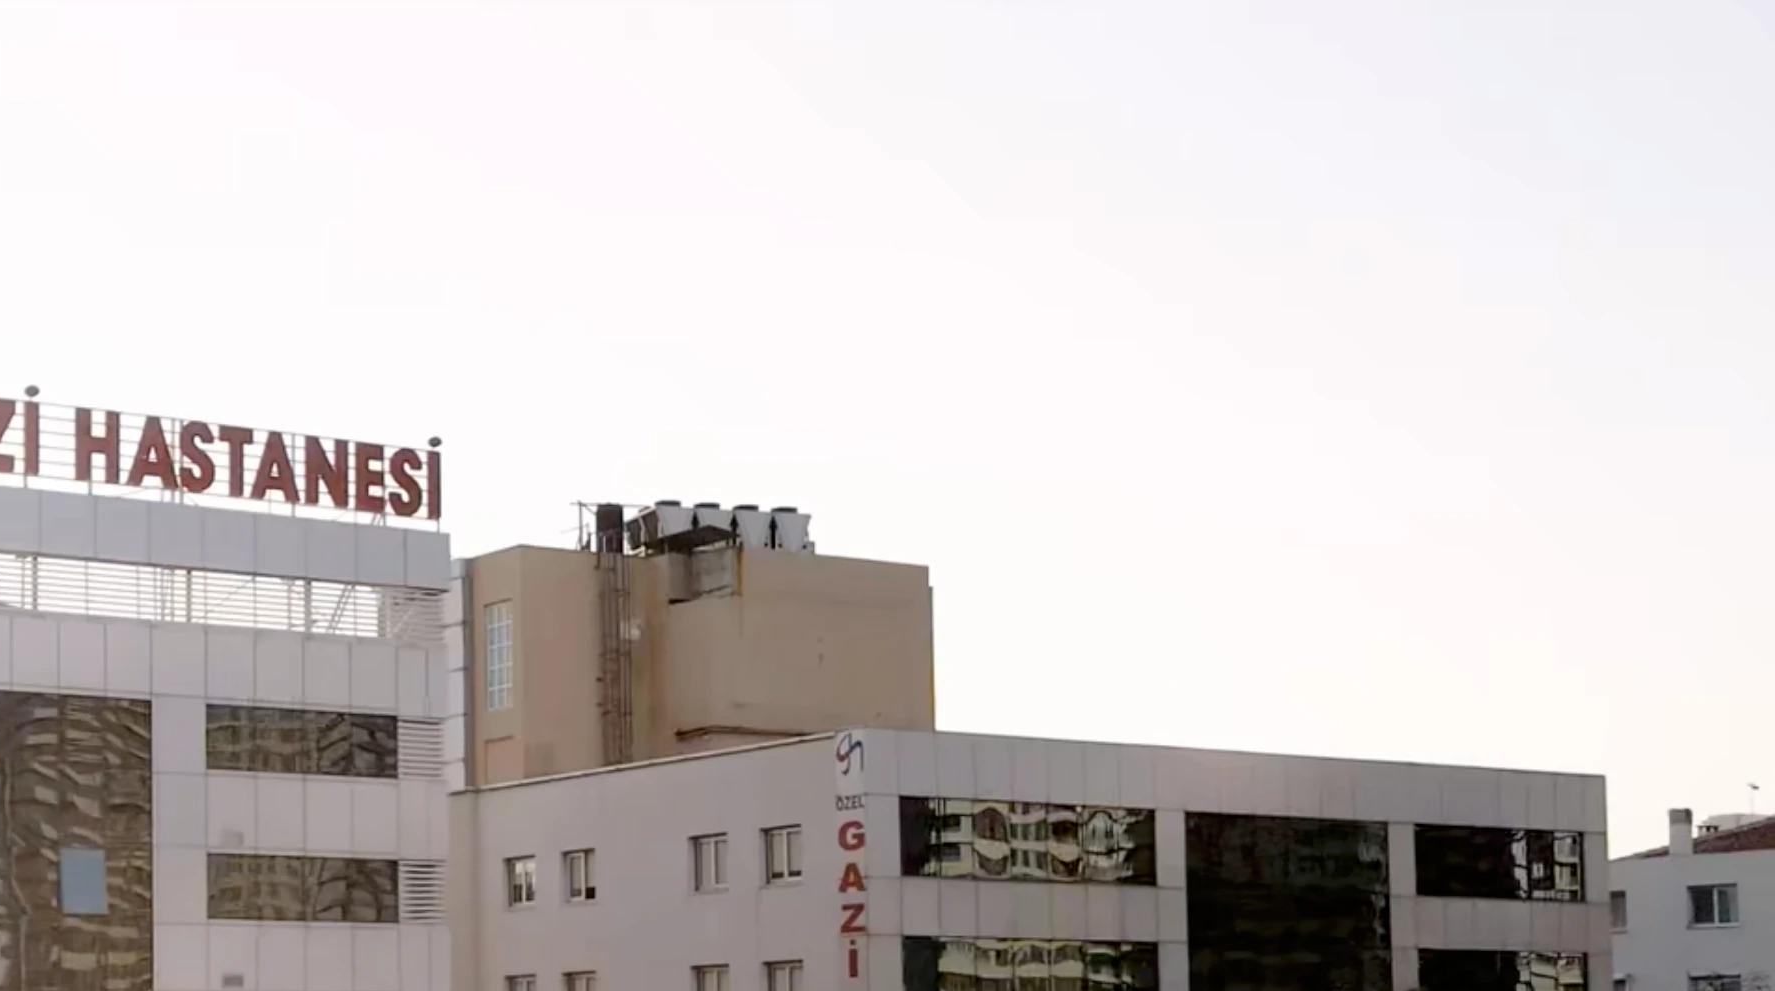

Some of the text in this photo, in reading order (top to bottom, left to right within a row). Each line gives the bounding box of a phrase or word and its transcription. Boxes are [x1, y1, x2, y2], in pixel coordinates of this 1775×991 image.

[75, 406, 442, 520] HASTANESİ
[835, 794, 865, 811] ÖZEL
[838, 820, 867, 978] GAZİ
